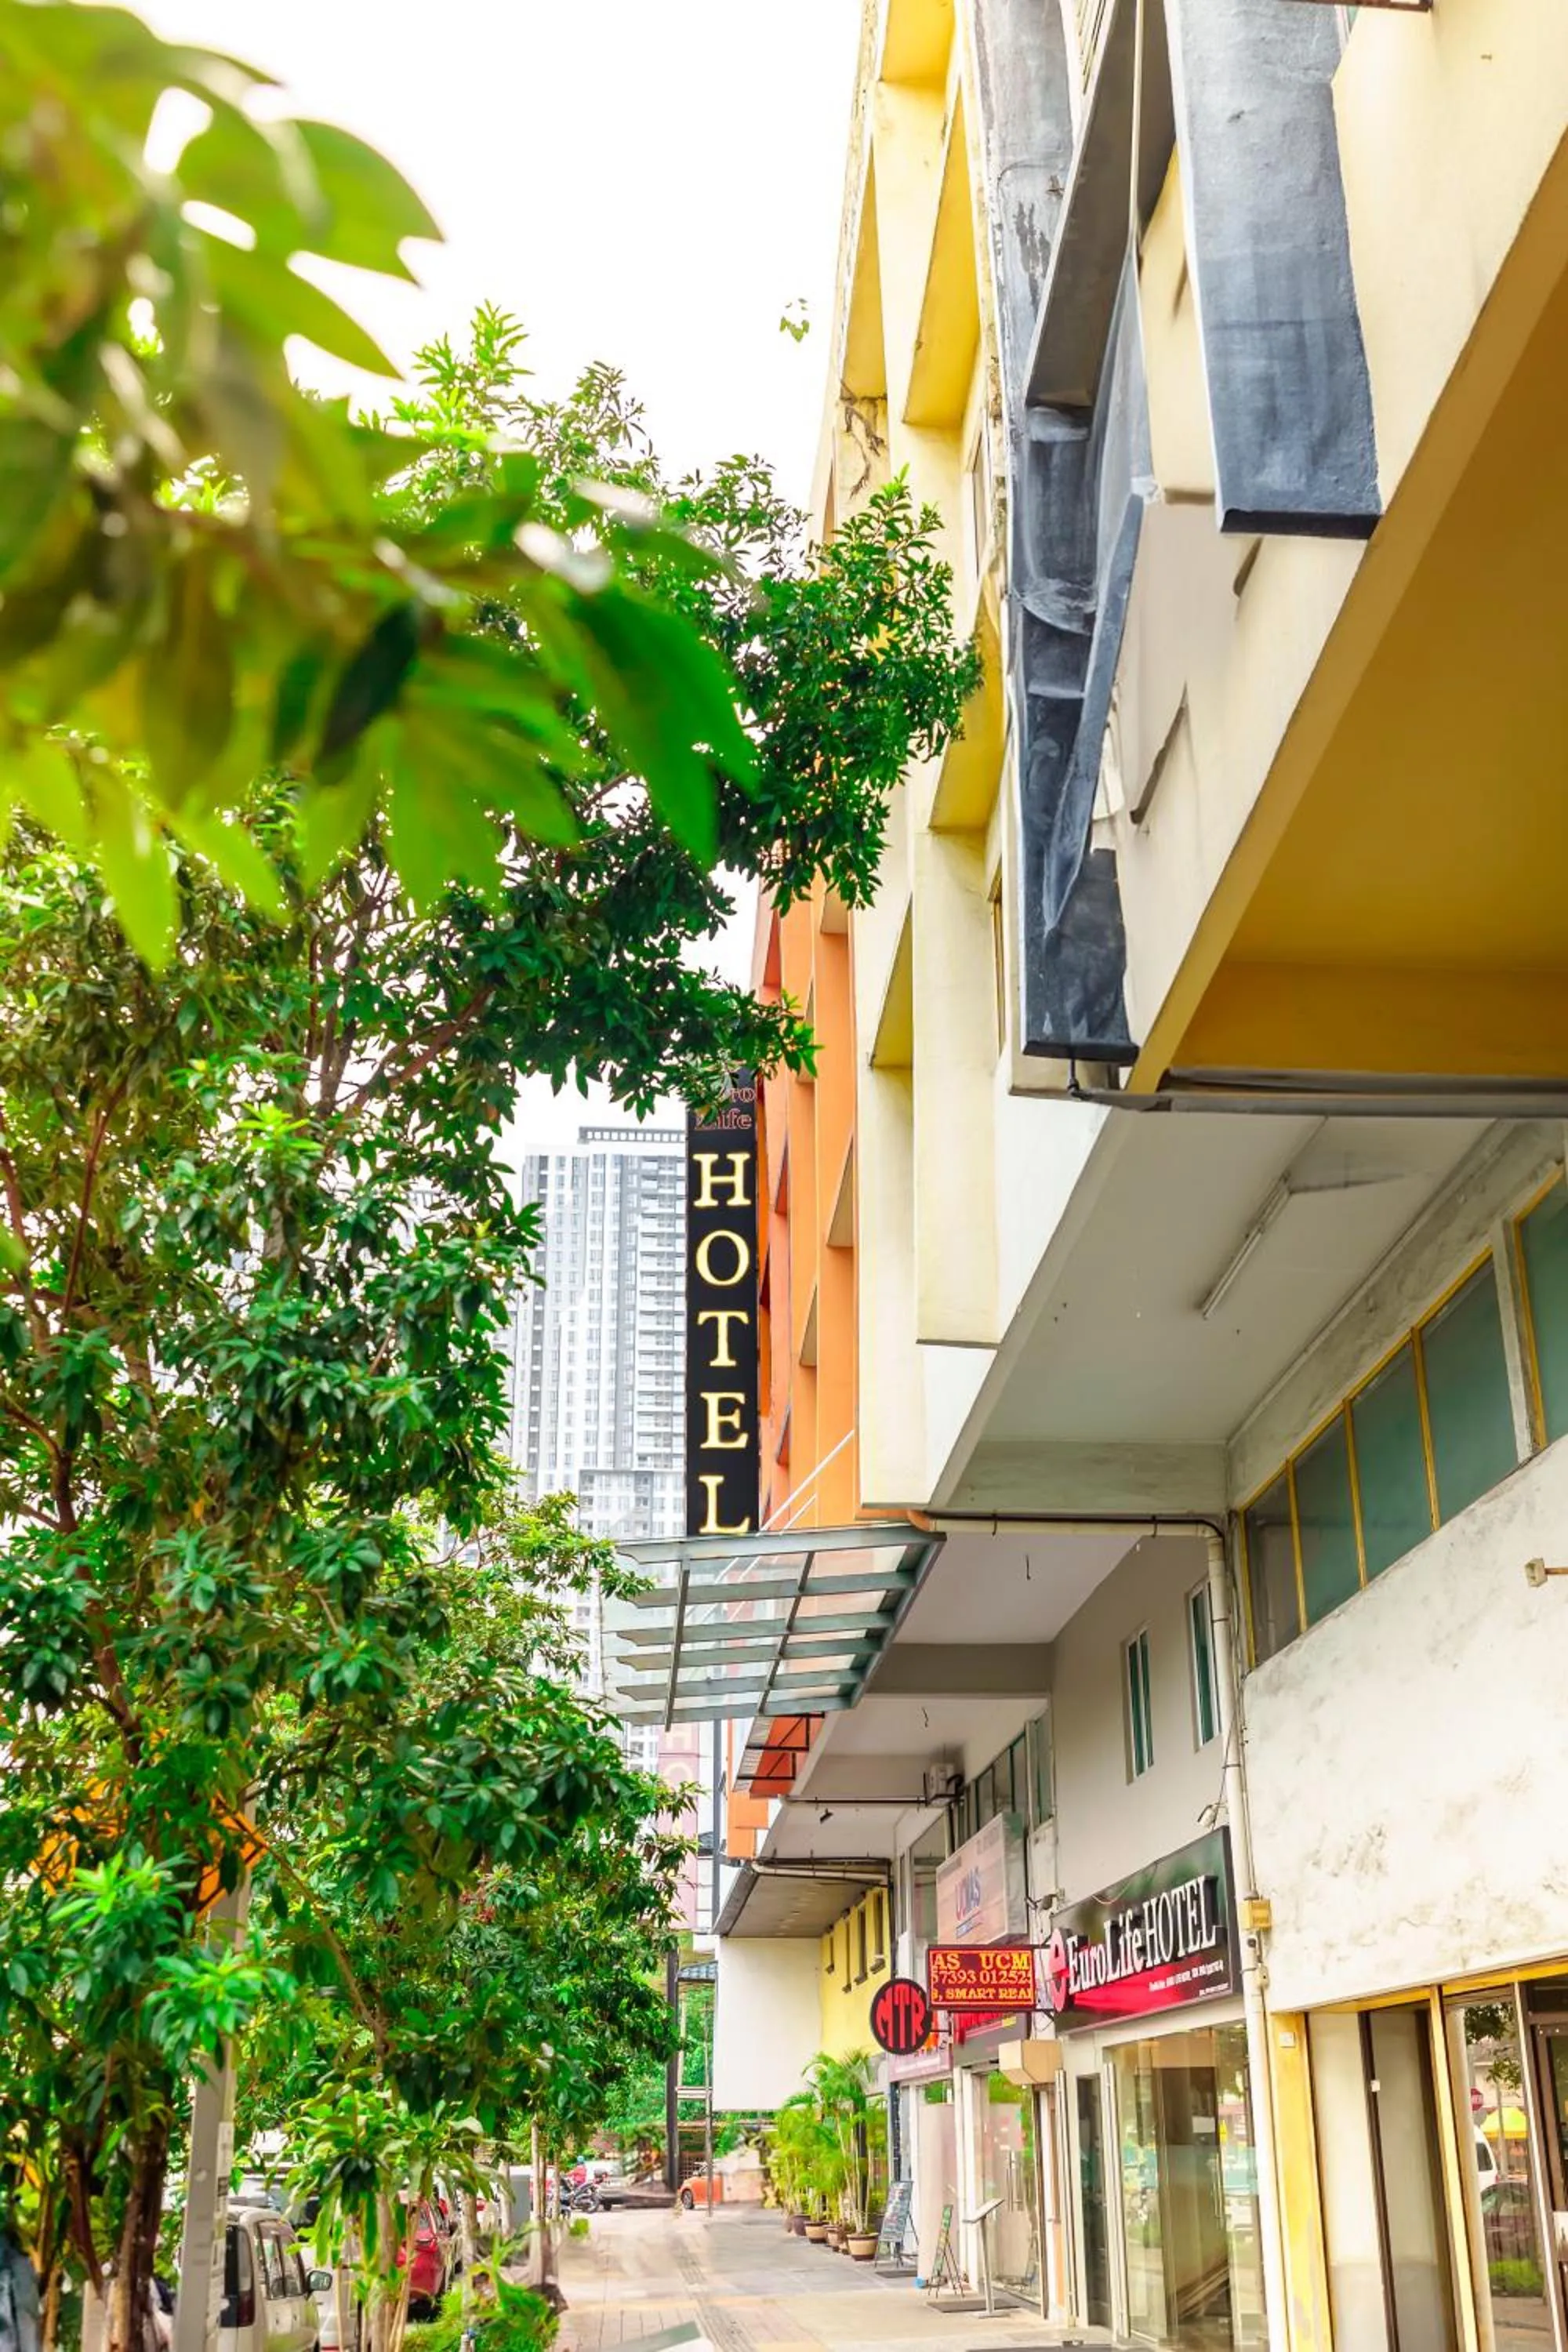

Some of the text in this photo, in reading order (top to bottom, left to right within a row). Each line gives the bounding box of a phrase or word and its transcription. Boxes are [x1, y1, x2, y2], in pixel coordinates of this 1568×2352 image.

[692, 1152, 752, 1534] HOTEL
[978, 1952, 1029, 1970] UCM
[945, 1987, 996, 1999] SMART
[876, 1983, 925, 2049] MTR
